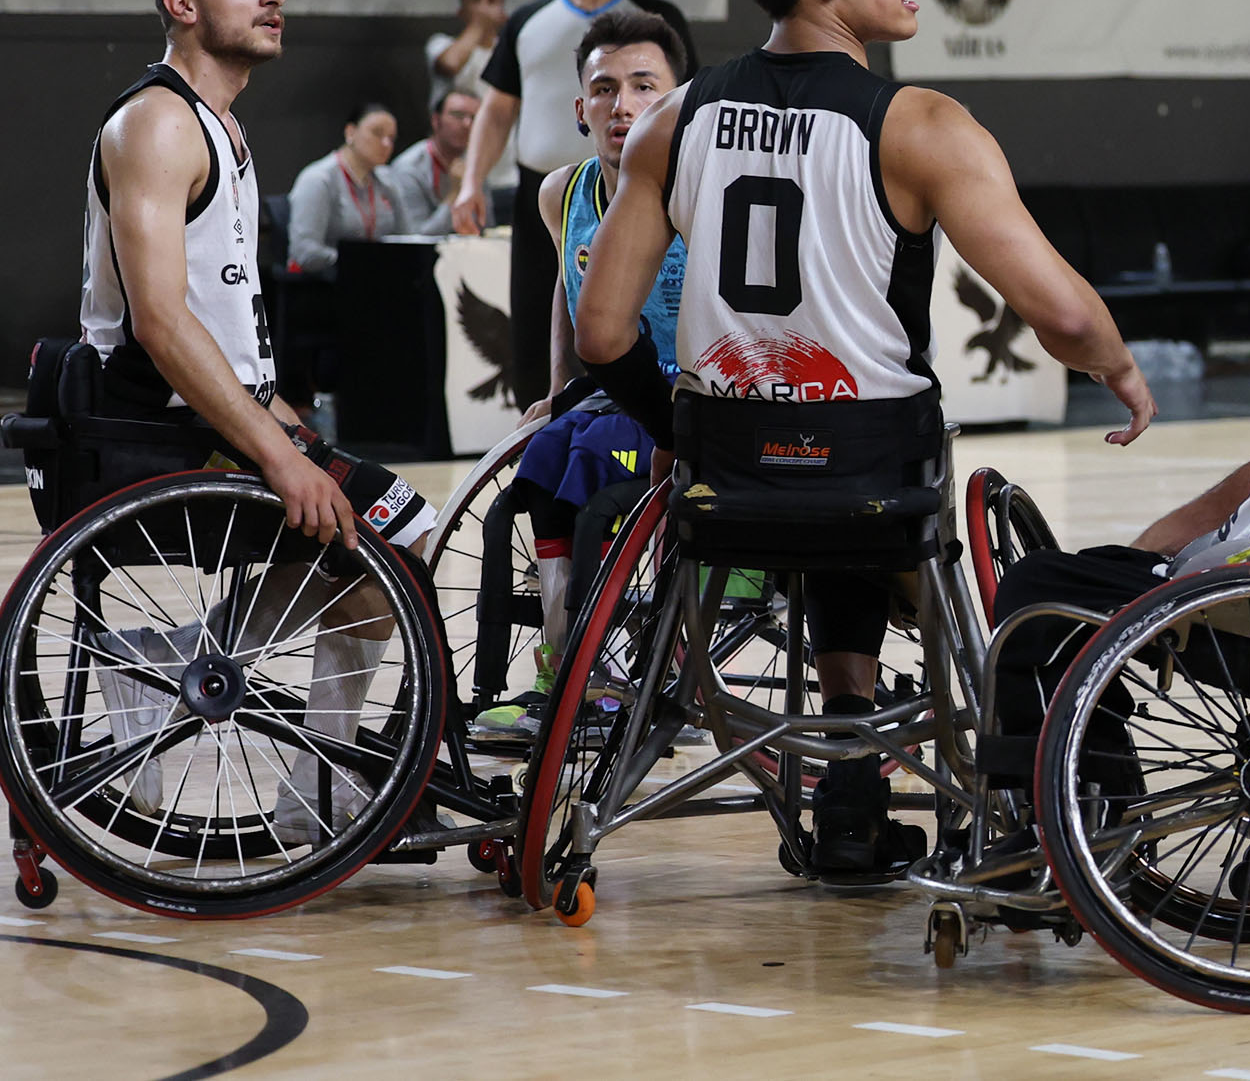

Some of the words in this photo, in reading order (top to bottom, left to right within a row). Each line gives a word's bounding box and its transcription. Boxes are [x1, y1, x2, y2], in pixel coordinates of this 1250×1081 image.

[716, 106, 816, 155] BROWN
[718, 174, 804, 317] 0
[711, 380, 858, 403] MARCA
[762, 442, 831, 457] Melrose
